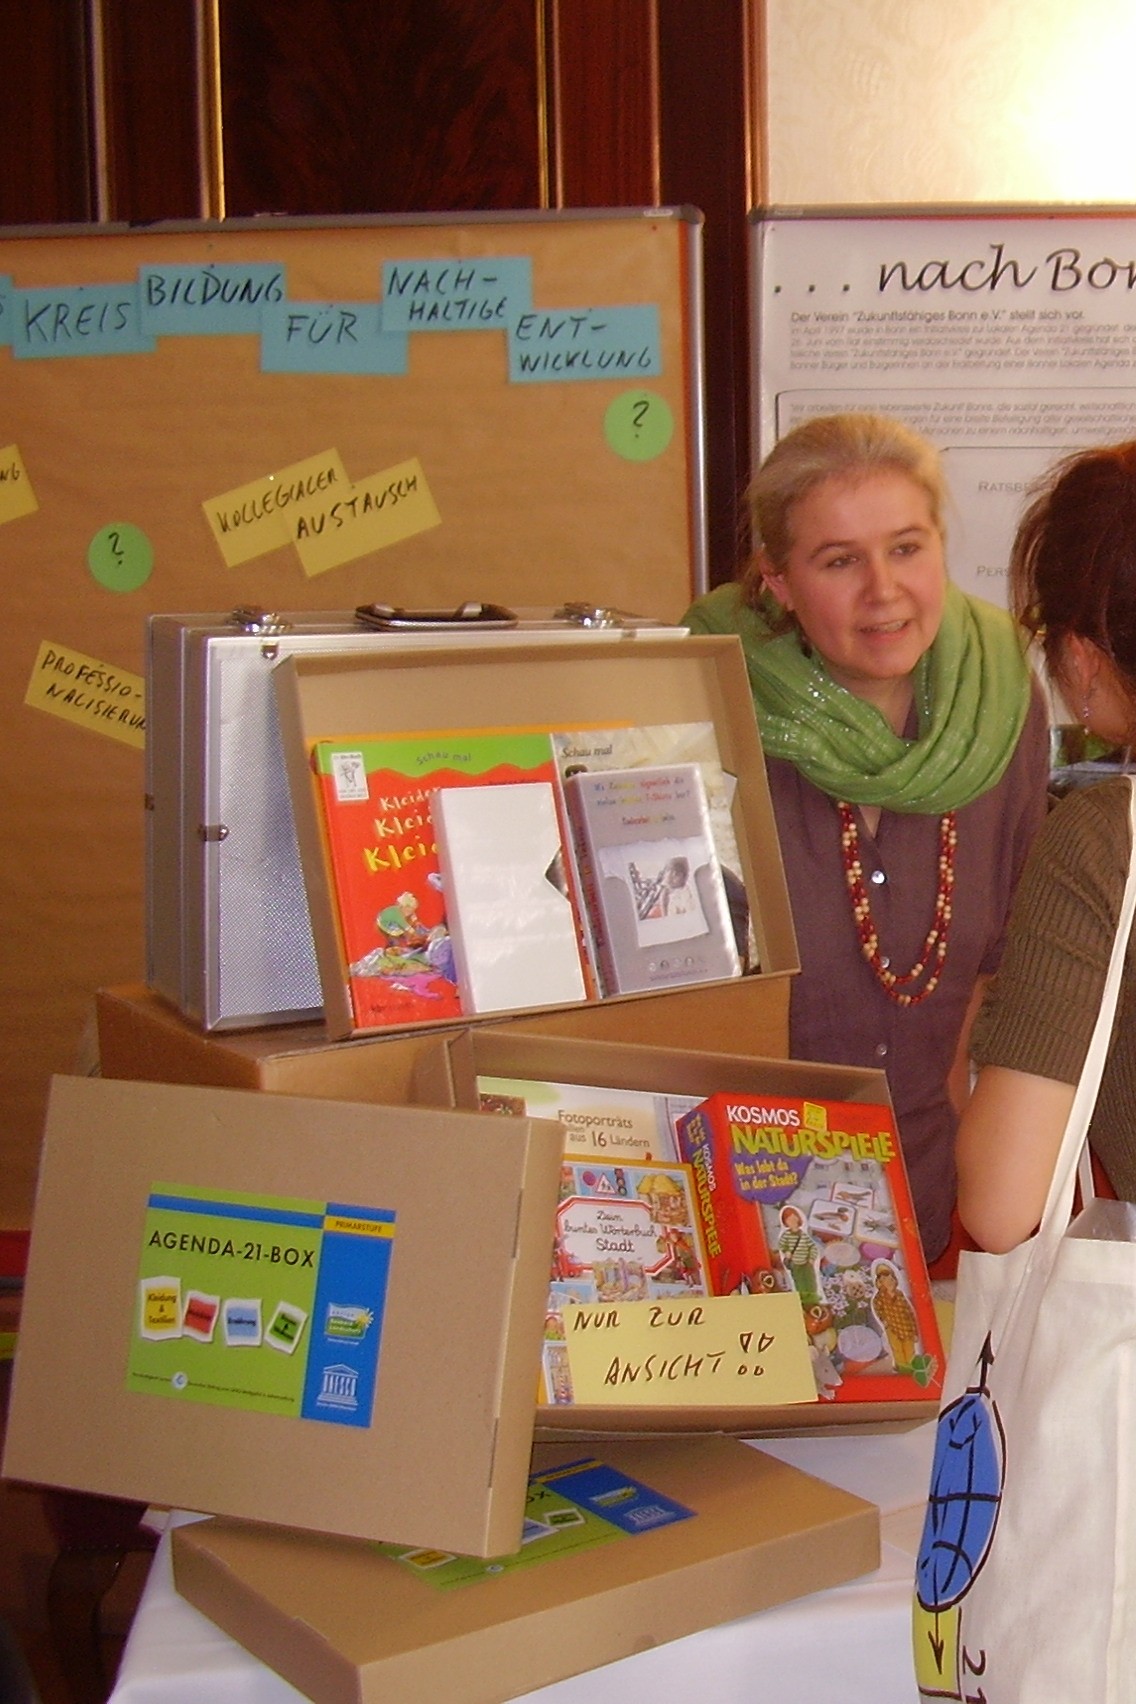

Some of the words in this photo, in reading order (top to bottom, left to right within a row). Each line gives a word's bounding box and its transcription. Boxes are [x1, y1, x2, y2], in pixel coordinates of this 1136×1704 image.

[877, 242, 1037, 293] nach
[24, 299, 132, 343] KREIS
[147, 269, 283, 307] BILDUNG
[285, 310, 358, 344] FÜR
[386, 266, 498, 296] NACH-
[790, 311, 811, 322] Der
[813, 310, 850, 322] Verein
[948, 309, 978, 321] Bonn
[1009, 309, 1036, 320] stellt
[1038, 309, 1062, 320] sich
[515, 313, 607, 341] ENT-
[519, 346, 652, 373] WICKLUNG
[631, 400, 650, 439] ?
[215, 467, 338, 534] KOLLEGIALER
[297, 474, 418, 541] AUSTAUSCH
[108, 531, 125, 567] ?
[561, 746, 592, 759] Schau
[593, 744, 613, 757] mal
[557, 1109, 634, 1130] Fotoporträts
[726, 1104, 801, 1127] KOSMOS
[569, 1132, 587, 1143] aus
[591, 1130, 607, 1148] 16
[609, 1133, 651, 1148] Ländern
[730, 1122, 897, 1164] NATURSPIELE
[600, 1222, 658, 1238] Wörterbuch
[149, 1229, 316, 1269] AGENDA-21-BOX
[595, 1237, 636, 1253] Stadt
[572, 1309, 621, 1332] NUR
[648, 1306, 706, 1328] ZUR
[603, 1350, 726, 1387] ANSICHT
